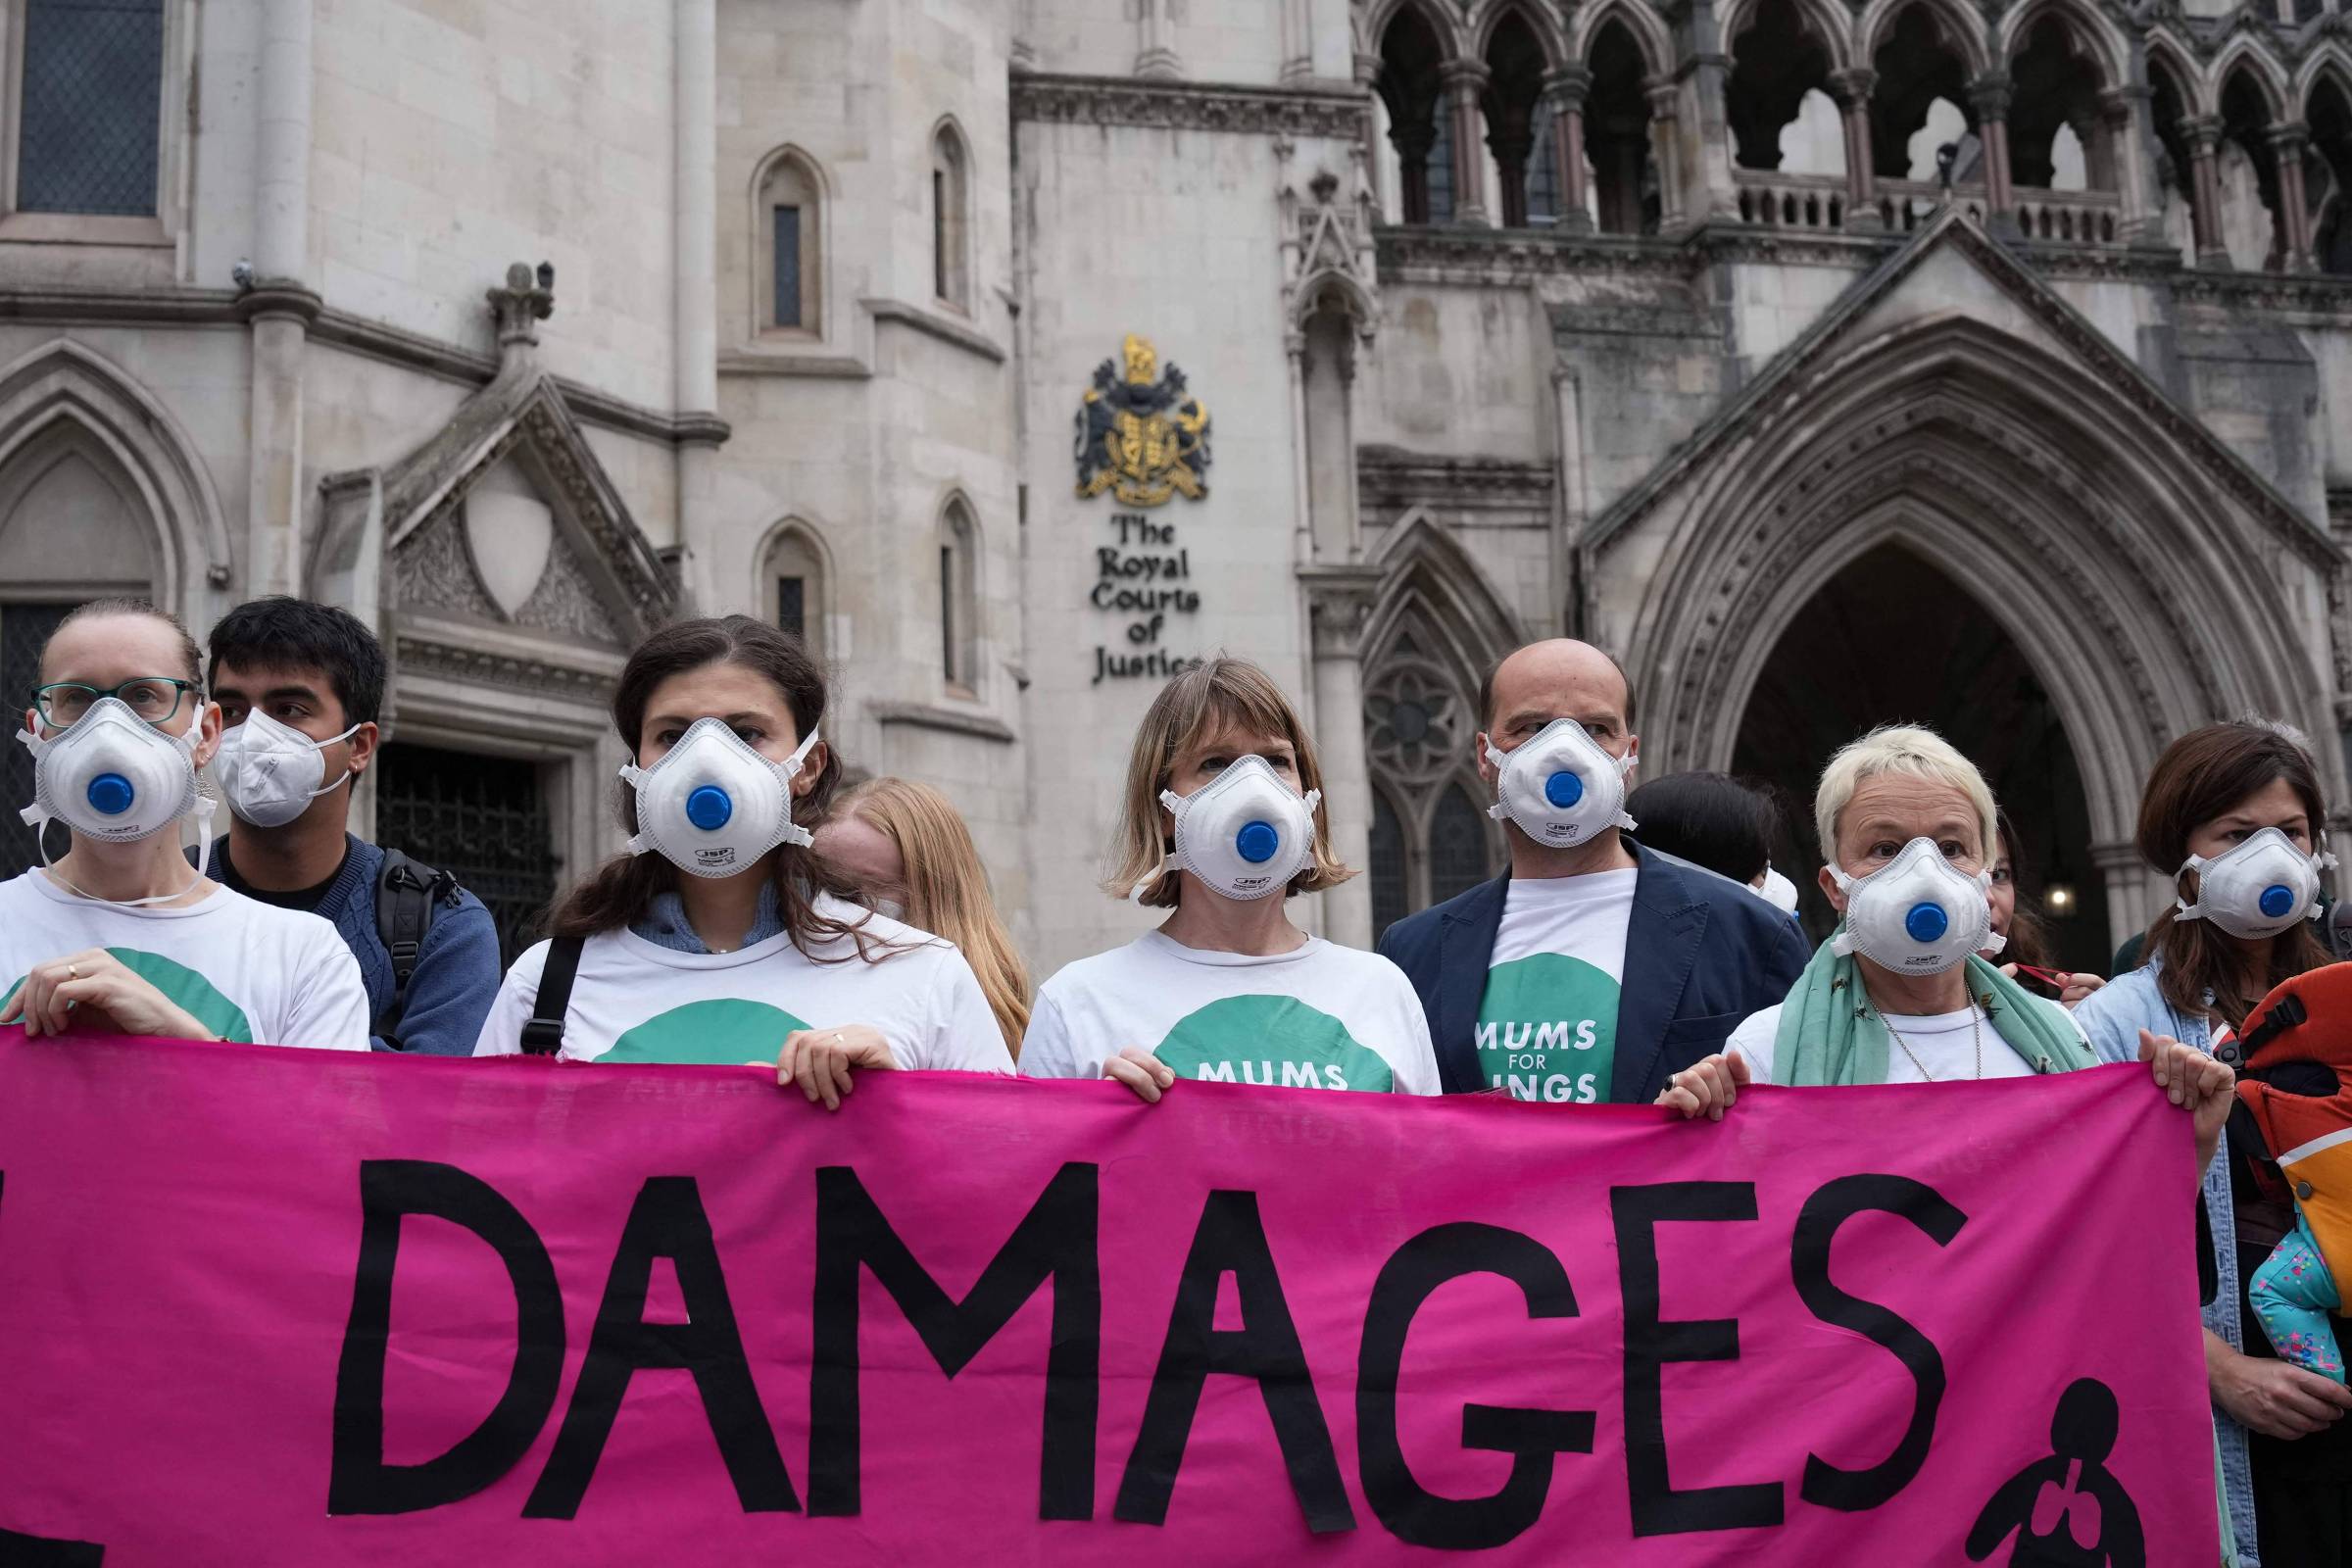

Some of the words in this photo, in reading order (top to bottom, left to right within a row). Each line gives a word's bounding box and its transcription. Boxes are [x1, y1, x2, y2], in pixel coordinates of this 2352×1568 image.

[1110, 514, 1175, 545] The
[1097, 547, 1189, 582] Royal
[1091, 582, 1200, 612] Courts
[1127, 613, 1164, 645] of
[702, 849, 728, 858] JSP
[1474, 1019, 1596, 1051] MUMS
[1198, 1060, 1348, 1091] MUMS
[1508, 1054, 1546, 1070] FOR
[327, 1158, 1968, 1550] DAMAGES
